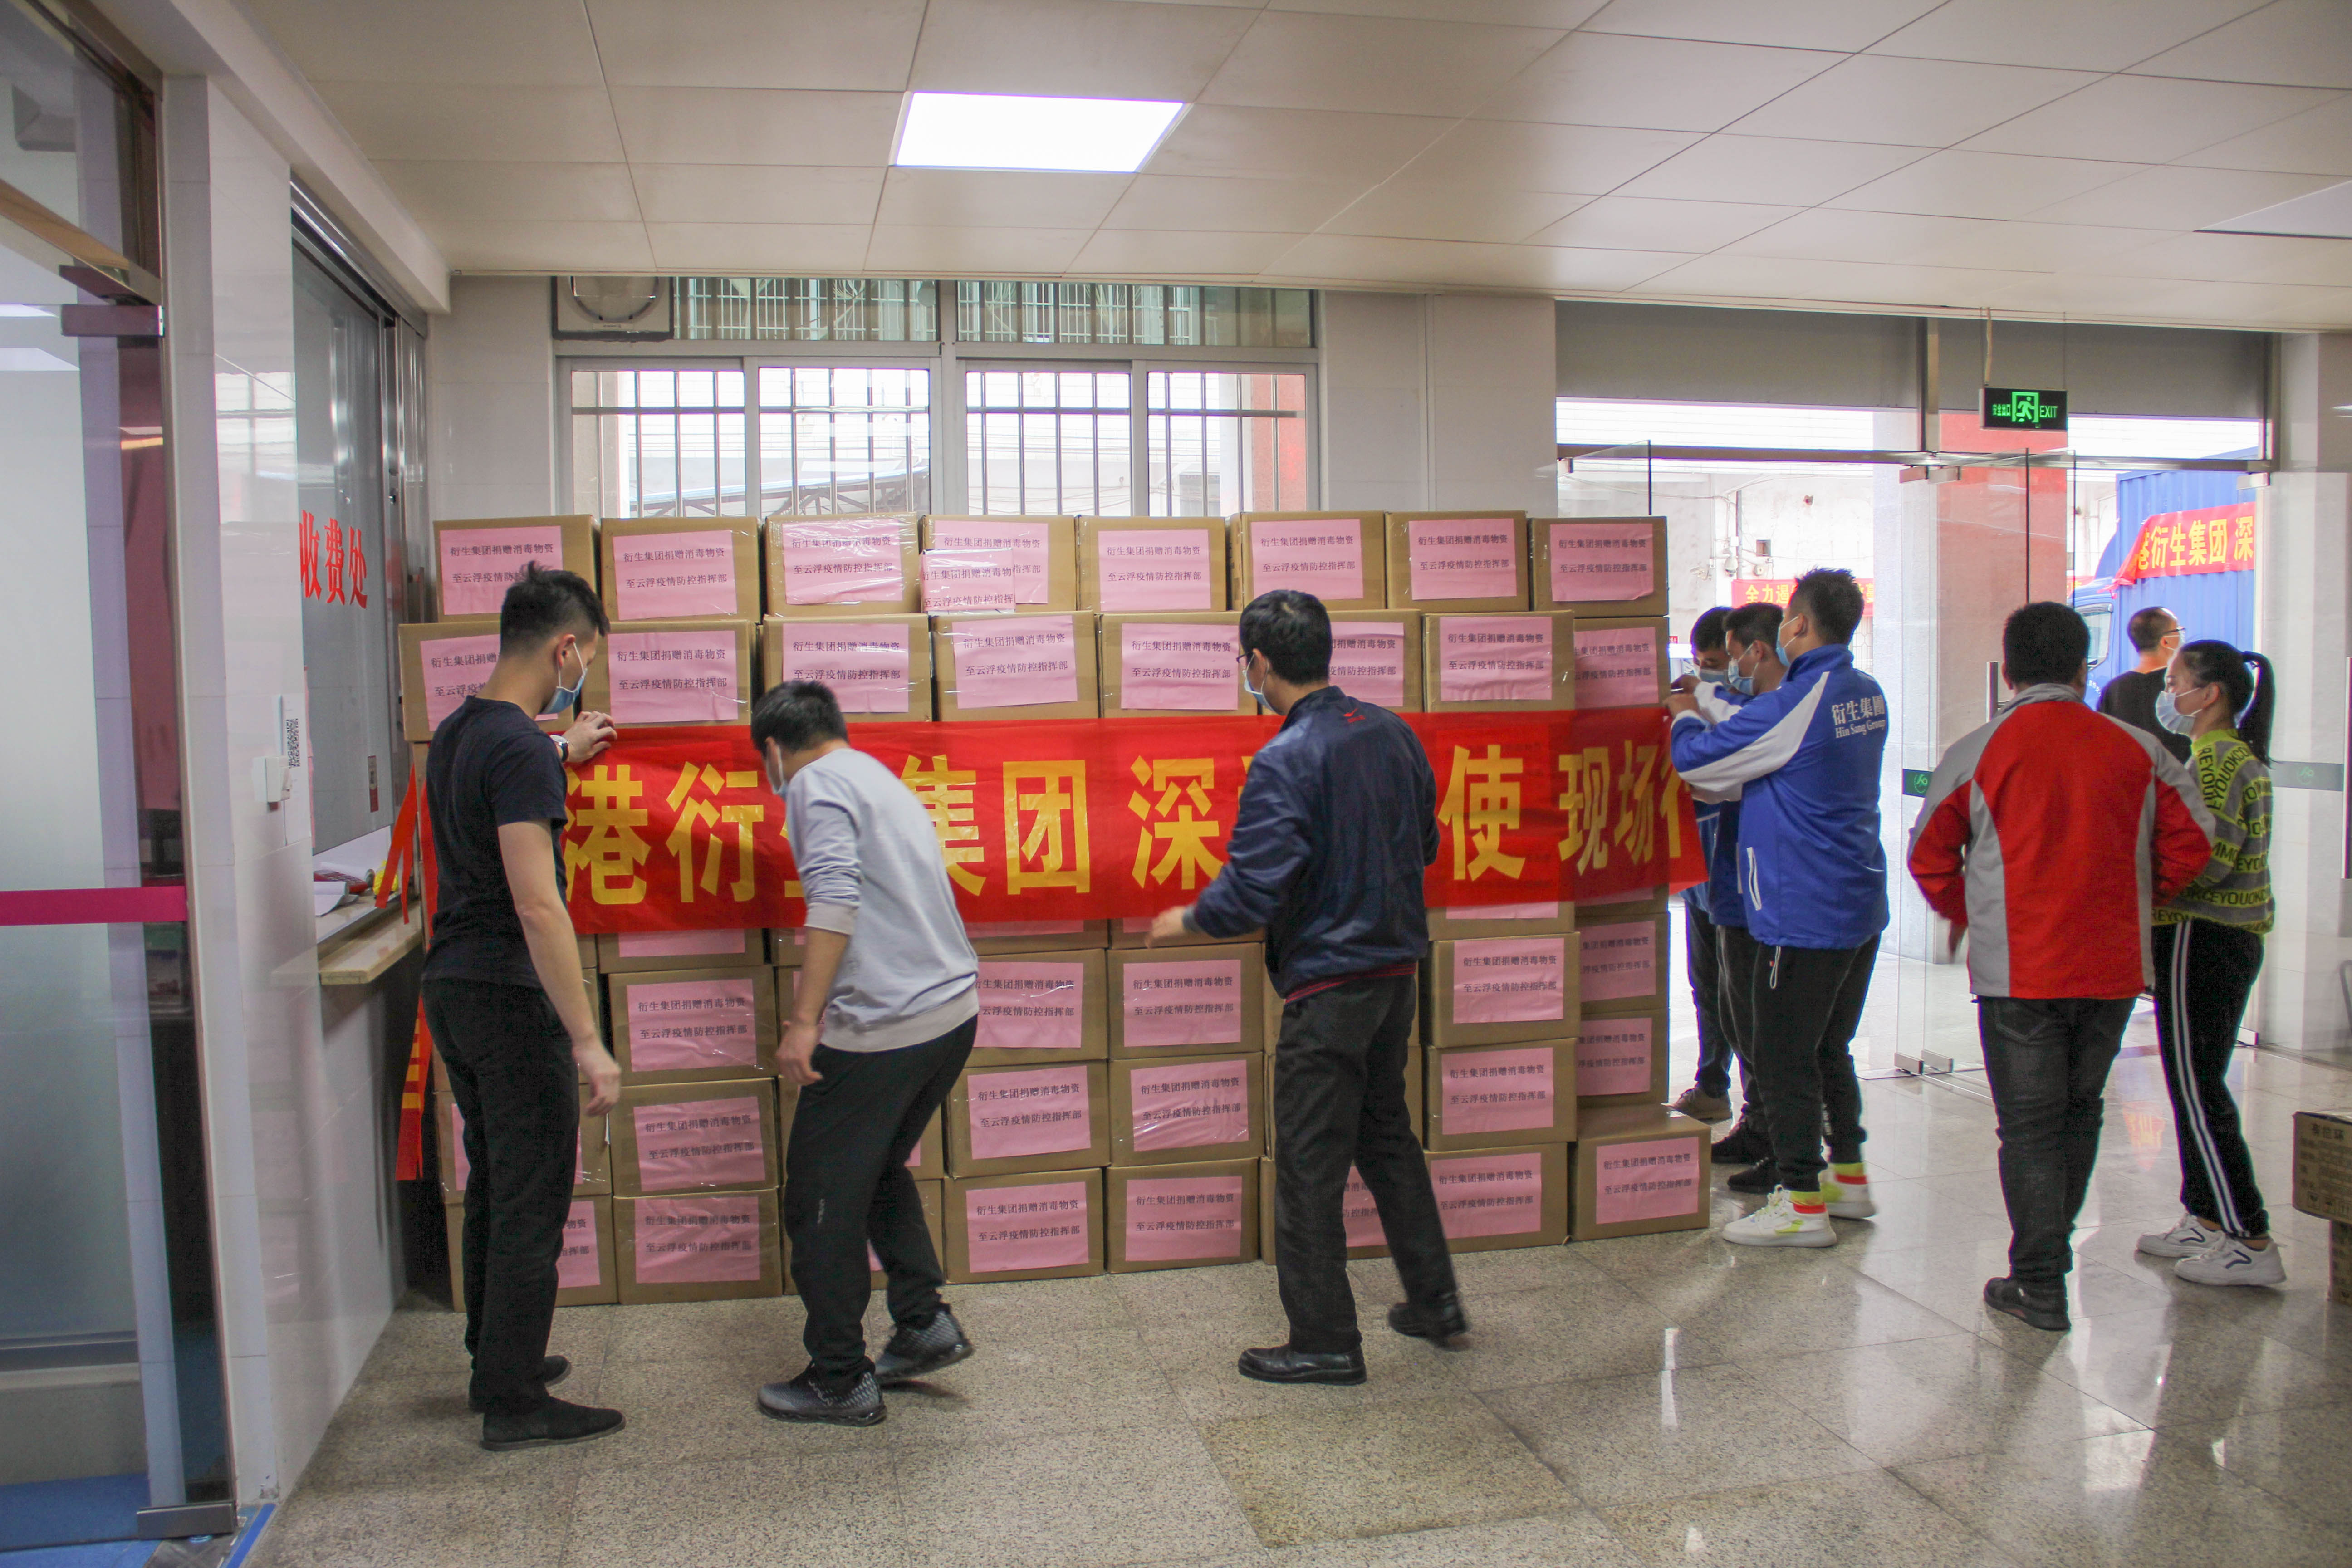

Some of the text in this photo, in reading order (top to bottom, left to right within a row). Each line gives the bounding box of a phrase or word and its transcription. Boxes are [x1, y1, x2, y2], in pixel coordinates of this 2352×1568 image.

[2039, 405, 2058, 418] EXIT
[792, 536, 891, 549] 衍生集团捐赠消毒物资
[944, 537, 1040, 549] 衍生集团捐赠消毒物资
[1261, 536, 1354, 547] 衍生集团捐赠消毒物资
[1418, 534, 1508, 546] 衍生集团捐赠消毒物资
[1559, 539, 1646, 549] 衍生集团捐赠消毒物资
[451, 543, 554, 557] 衍生集团捐赠消毒物资
[623, 548, 725, 562] 衍生集团捐赠消毒物资
[1107, 546, 1200, 556] 衍生集团捐赠消毒物资
[299, 509, 368, 609] 收费处
[1420, 559, 1509, 570] 至云浮疫情防控指挥部
[793, 562, 893, 574] 至云浮疫情防控指挥部
[1262, 561, 1355, 573] 至云浮疫情防控指挥部
[1560, 564, 1647, 573] 至云浮疫情防控指挥部
[626, 574, 727, 589] 至云浮疫情防控指挥部
[1108, 572, 1202, 582] 至云浮疫情防控指挥部
[1745, 584, 1798, 604] 全力遏
[963, 633, 1066, 649] 衍生集团捐赠消毒物资
[1448, 633, 1543, 644] 衍生集团捐赠消毒物资
[793, 641, 900, 652] 衍生集团捐赠消毒物资
[1132, 640, 1231, 652] 衍生集团捐赠消毒物资
[617, 649, 726, 662] 衍生集团捐赠消毒物资
[965, 661, 1068, 676] 至云浮疫情防控指挥部
[1448, 660, 1544, 671] 至云浮疫情防控指挥部
[794, 669, 901, 680] 至云浮疫情防控指挥部
[1132, 667, 1231, 678] 至云浮疫情防控指挥部
[619, 677, 727, 690] 至云浮疫情防控指挥部
[1463, 956, 1557, 967] 衍生集团捐赠消毒物资
[1133, 977, 1233, 990] 衍生集团捐赠消毒物资
[1464, 981, 1557, 992] 至云浮疫情防控指挥部
[638, 997, 745, 1012] 衍生集团捐赠消毒物资
[1135, 1004, 1234, 1016] 至云浮疫情防控指挥部
[640, 1025, 747, 1039] 至云浮疫情防控指挥部
[1450, 1064, 1544, 1079] 衍生集团捐赠消毒物资
[1141, 1077, 1240, 1094] 衍生集团捐赠消毒物资
[978, 1083, 1079, 1102] 衍生集团捐赠消毒物资
[1451, 1090, 1546, 1104] 至云浮疫情防控指挥部
[1142, 1103, 1240, 1121] 至云浮疫情防控指挥部
[646, 1114, 751, 1133] 衍生集团捐赠消毒物资
[980, 1110, 1082, 1128] 至云浮疫情防控指挥部
[648, 1142, 754, 1160] 至云浮疫情防控指挥部
[1604, 1153, 1691, 1171] 衍生集团捐赠消毒物资
[1439, 1169, 1533, 1185] 衍生集团捐赠消毒物资
[1604, 1178, 1692, 1195] 至云浮疫情防控指挥部
[1137, 1193, 1234, 1206] 衍生集团捐赠消毒物资
[1440, 1195, 1534, 1210] 至云浮疫情防控指挥部
[977, 1200, 1078, 1215] 衍生集团捐赠消毒物资
[645, 1215, 750, 1226] 衍生集团捐赠消毒物资
[1137, 1219, 1235, 1231] 至云浮疫情防控指挥部
[978, 1225, 1080, 1241] 至云浮疫情防控指挥部
[646, 1241, 751, 1253] 至云浮疫情防控指挥部
